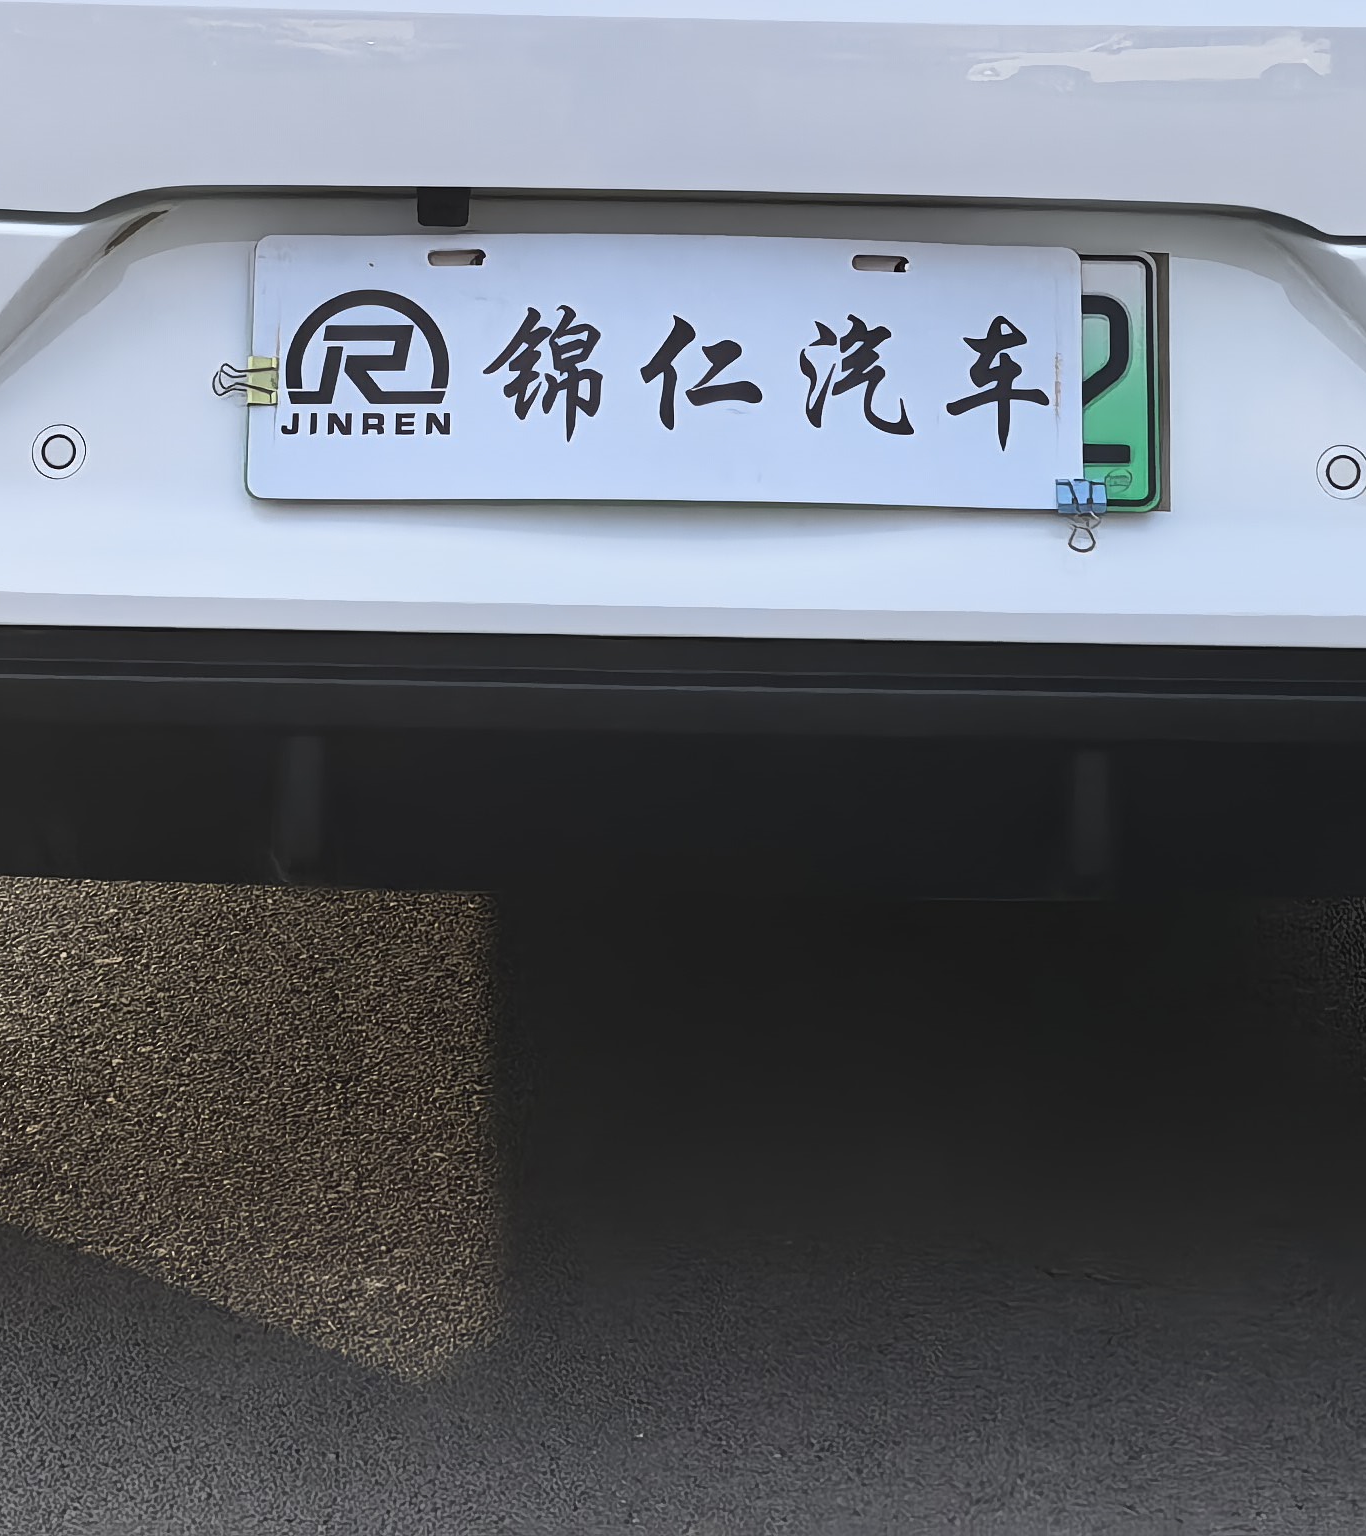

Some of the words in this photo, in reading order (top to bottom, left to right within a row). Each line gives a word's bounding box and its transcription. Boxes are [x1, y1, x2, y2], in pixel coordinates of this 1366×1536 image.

[482, 304, 1049, 452] 锦仁汽车
[280, 412, 451, 435] JINREN
